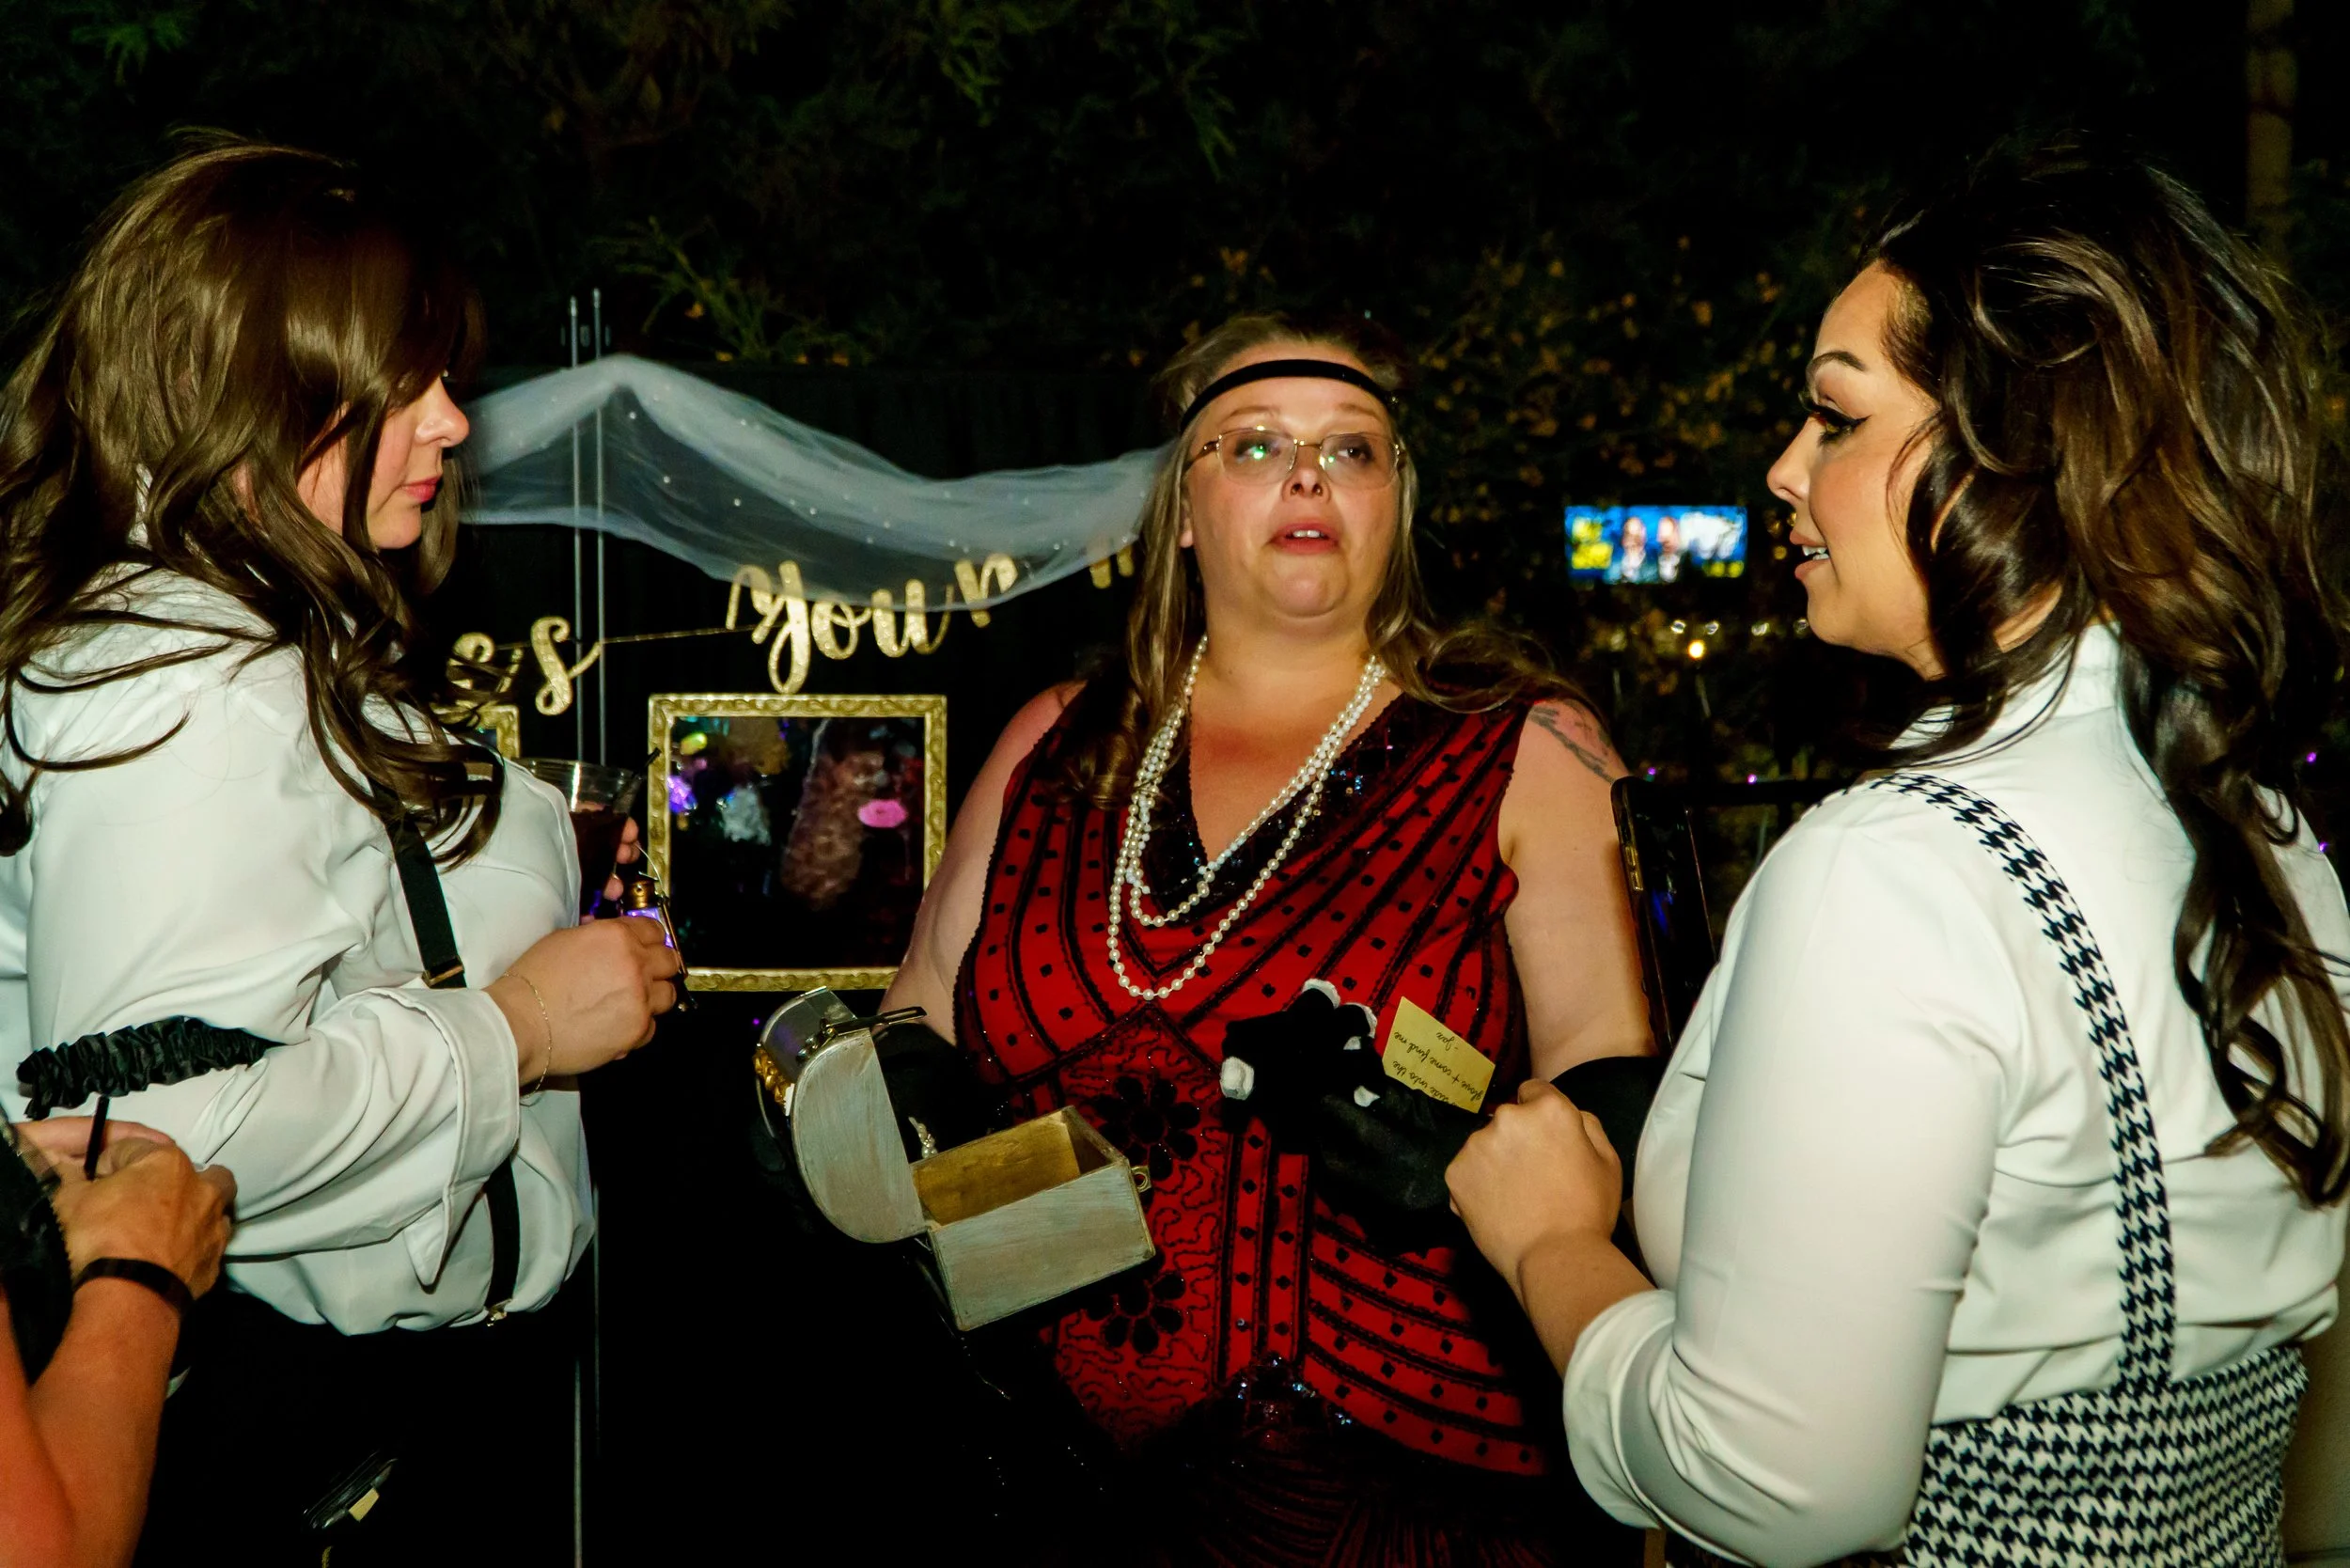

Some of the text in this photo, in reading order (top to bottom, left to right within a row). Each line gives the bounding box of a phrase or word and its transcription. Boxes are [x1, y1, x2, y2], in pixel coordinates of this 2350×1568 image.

[1392, 1060, 1407, 1077] the
[1393, 1031, 1484, 1102] glove + come find me
[1409, 1072, 1428, 1089] into
